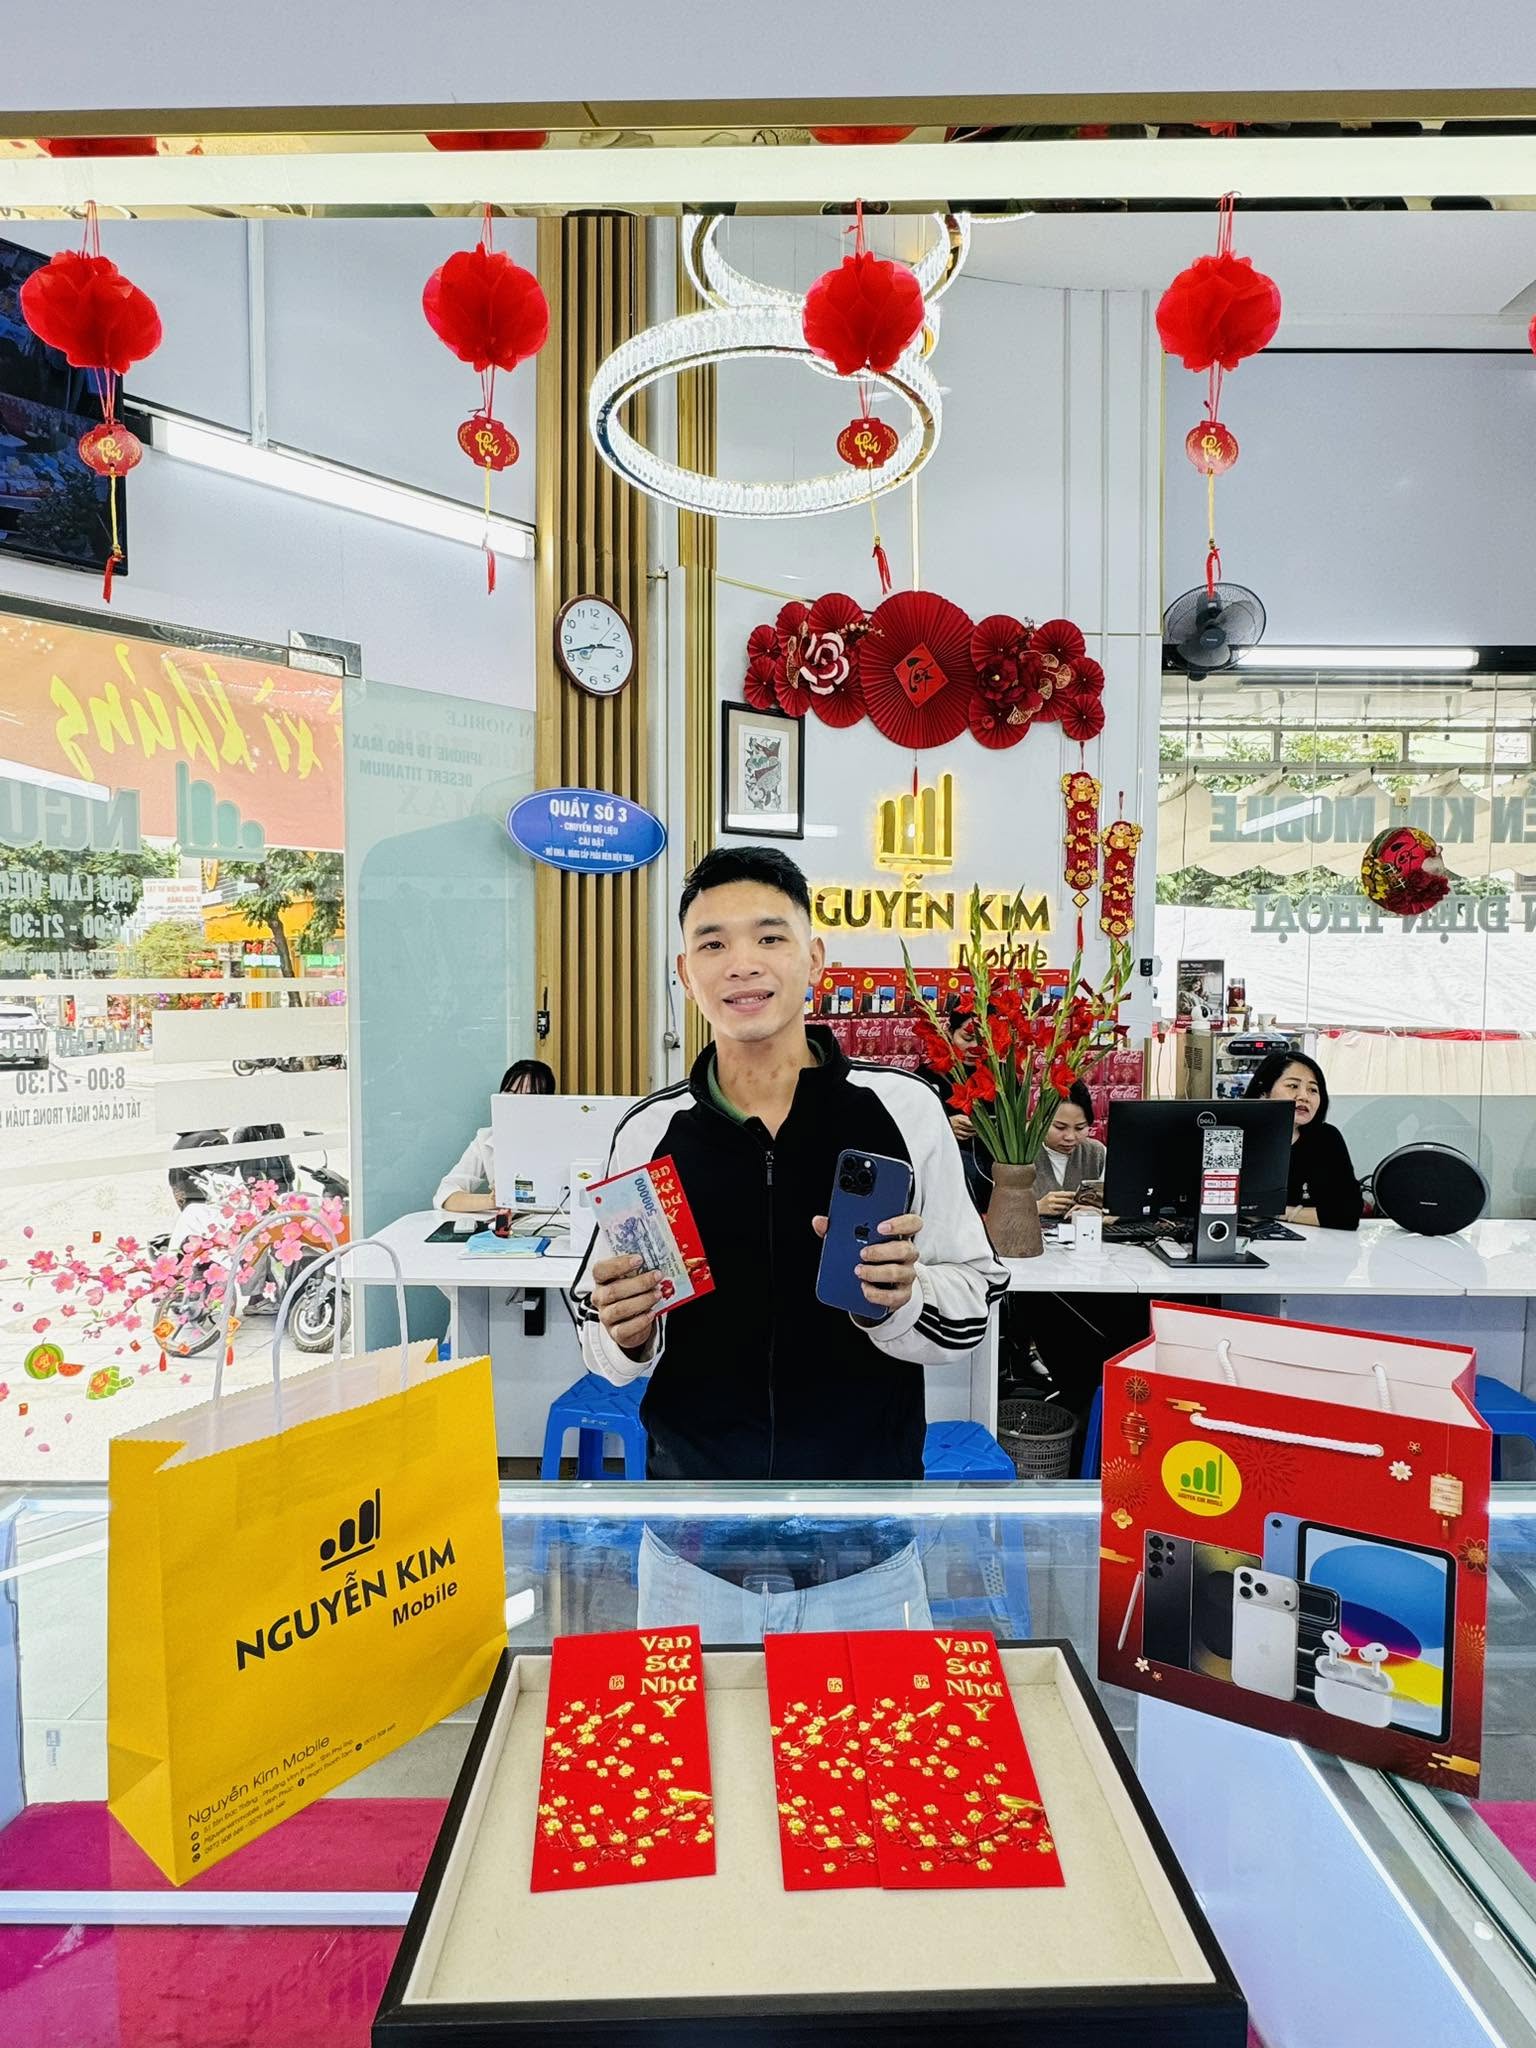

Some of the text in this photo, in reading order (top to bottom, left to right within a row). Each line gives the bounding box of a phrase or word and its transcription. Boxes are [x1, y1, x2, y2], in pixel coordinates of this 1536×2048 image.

[577, 608, 585, 618] 11
[590, 608, 600, 619] 12
[607, 617, 610, 625] 1
[567, 618, 576, 629] 10
[564, 634, 573, 644] 9
[612, 632, 621, 642] 2
[566, 651, 576, 662] 8
[616, 649, 624, 658] 3
[576, 667, 584, 676] 7
[612, 664, 620, 673] 4
[589, 675, 598, 685] 6
[603, 674, 611, 683] 5
[549, 796, 627, 822] QUẦY SỐ 3
[578, 836, 590, 846] CÀI
[807, 873, 1050, 931] GUYỄN KIM
[650, 1165, 671, 1181] ạn
[634, 1177, 657, 1217] 500000
[661, 1191, 682, 1208] hư
[236, 1537, 456, 1671] NGUYỄN KIM
[392, 1580, 458, 1627] Mobile
[639, 1635, 692, 1652] Vạn
[934, 1637, 989, 1656] Vạn
[644, 1654, 692, 1673] Sự
[945, 1657, 993, 1677] Sự
[640, 1675, 698, 1695] Như
[945, 1679, 1004, 1697] Như
[652, 1695, 687, 1718] Ý
[962, 1698, 996, 1721] Ý
[188, 1784, 249, 1828] Nguyễn
[253, 1766, 280, 1789] Kim
[282, 1736, 330, 1770] Mobile
